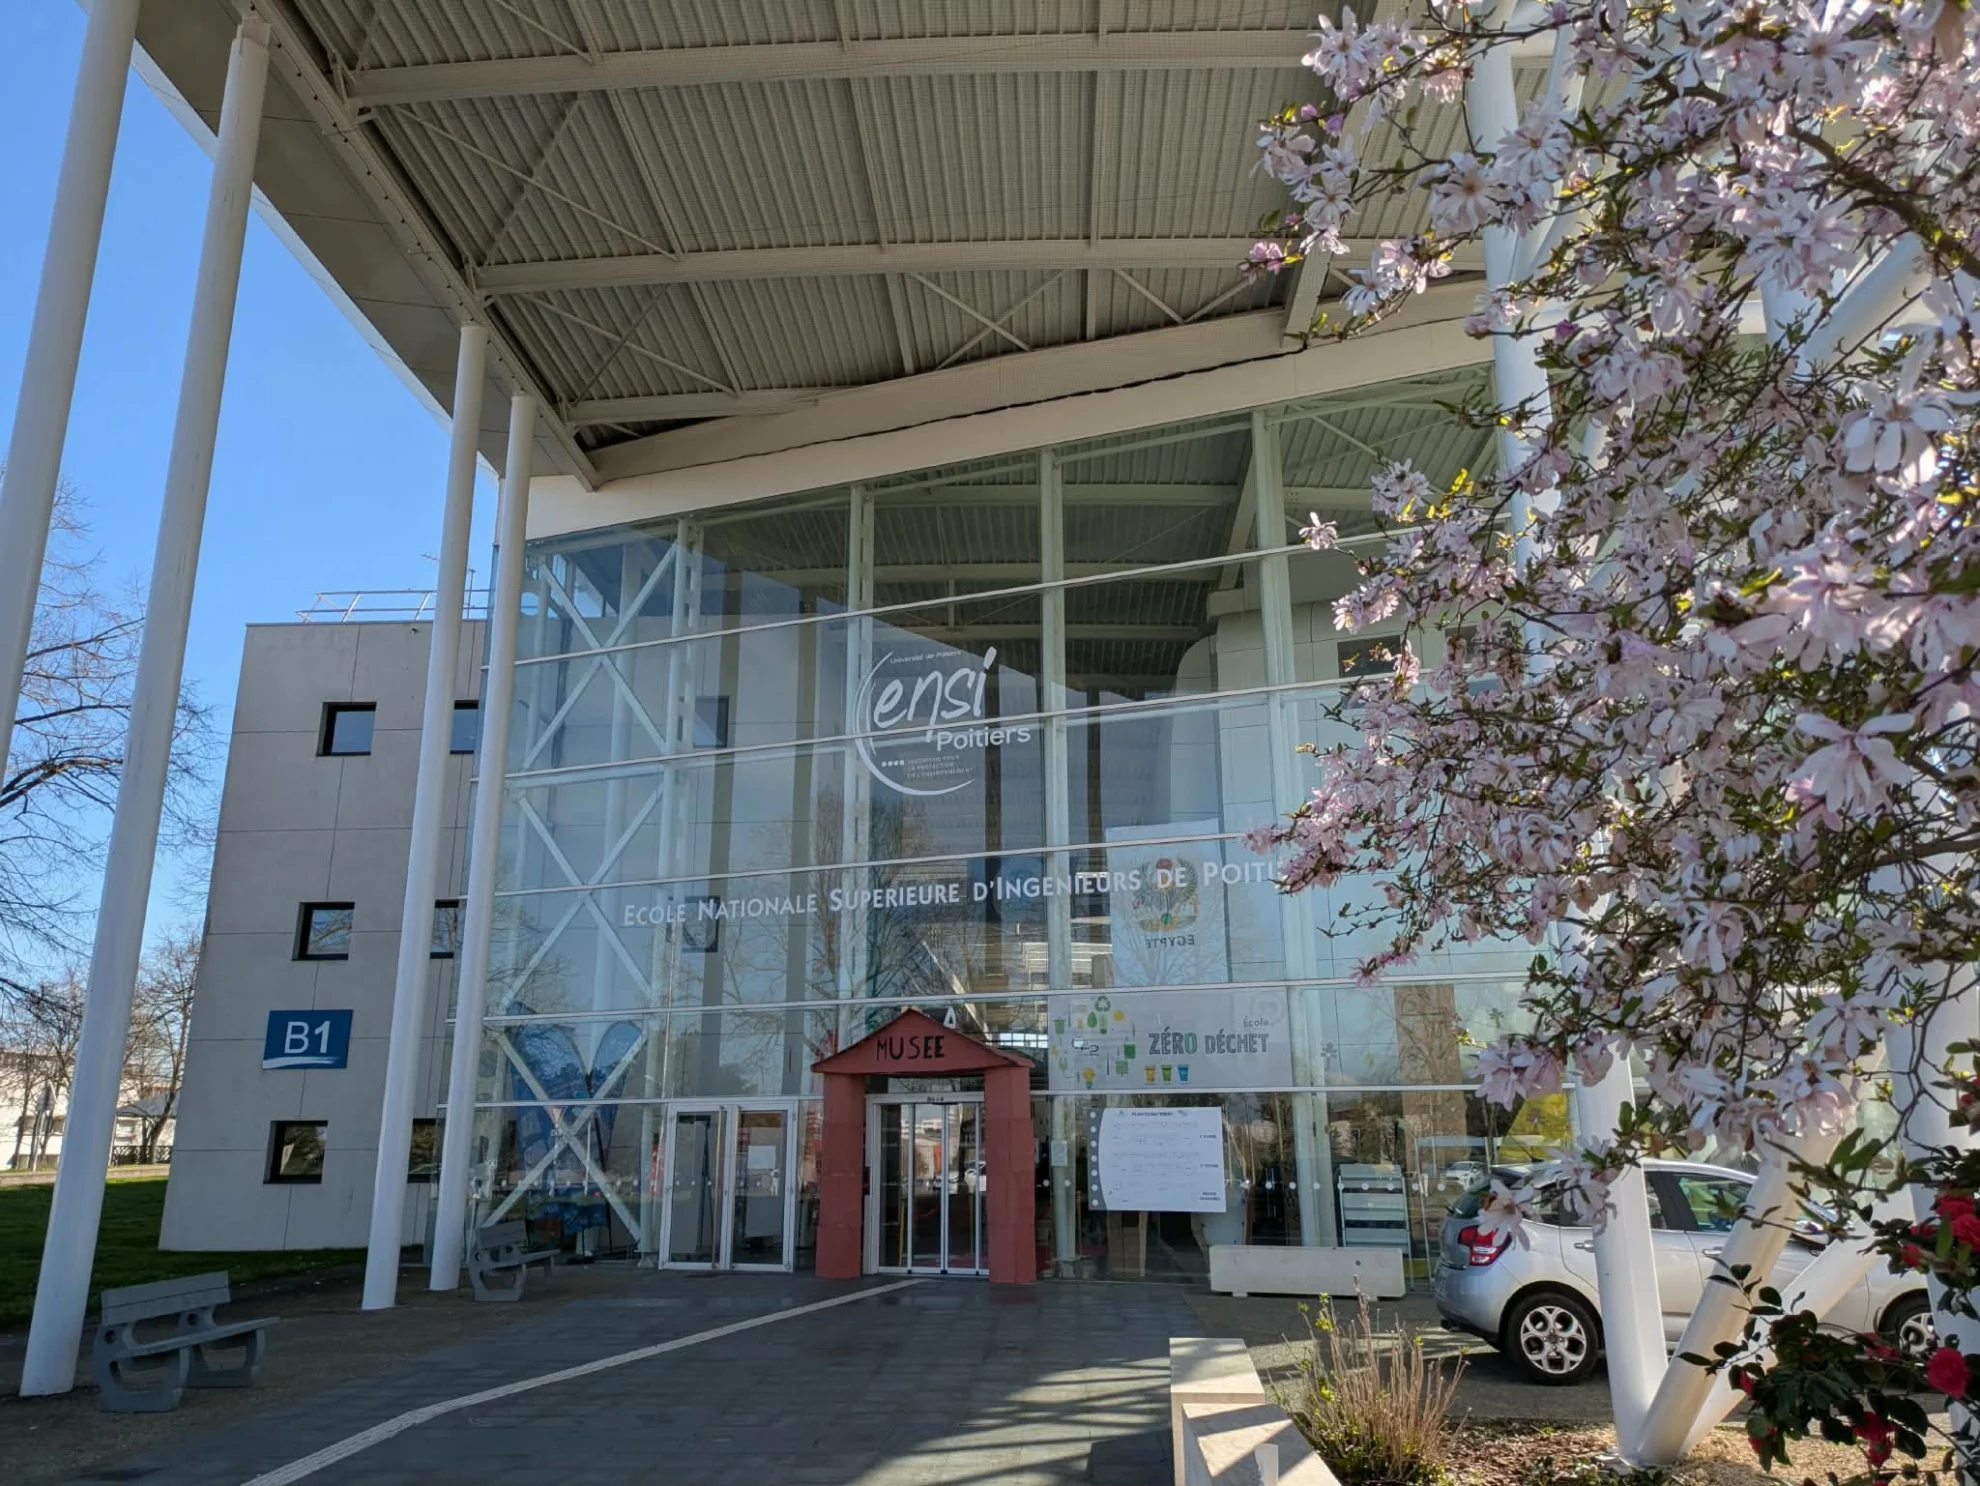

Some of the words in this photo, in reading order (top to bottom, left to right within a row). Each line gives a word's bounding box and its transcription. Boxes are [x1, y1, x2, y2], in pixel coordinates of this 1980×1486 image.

[873, 646, 998, 743] ensi
[936, 726, 1031, 751] Poitiers
[698, 894, 817, 921] NATIONALE
[830, 883, 960, 911] SUPERIEURE
[974, 869, 1142, 901] D'INGENIEURS
[1157, 867, 1187, 889] DE
[1203, 860, 1275, 886] POITI
[1243, 1015, 1269, 1028] École
[284, 1020, 330, 1053] B1
[876, 1035, 945, 1062] MUSEE
[1148, 1026, 1198, 1055] ZÉRO
[1205, 1028, 1269, 1054] DÉCHET
